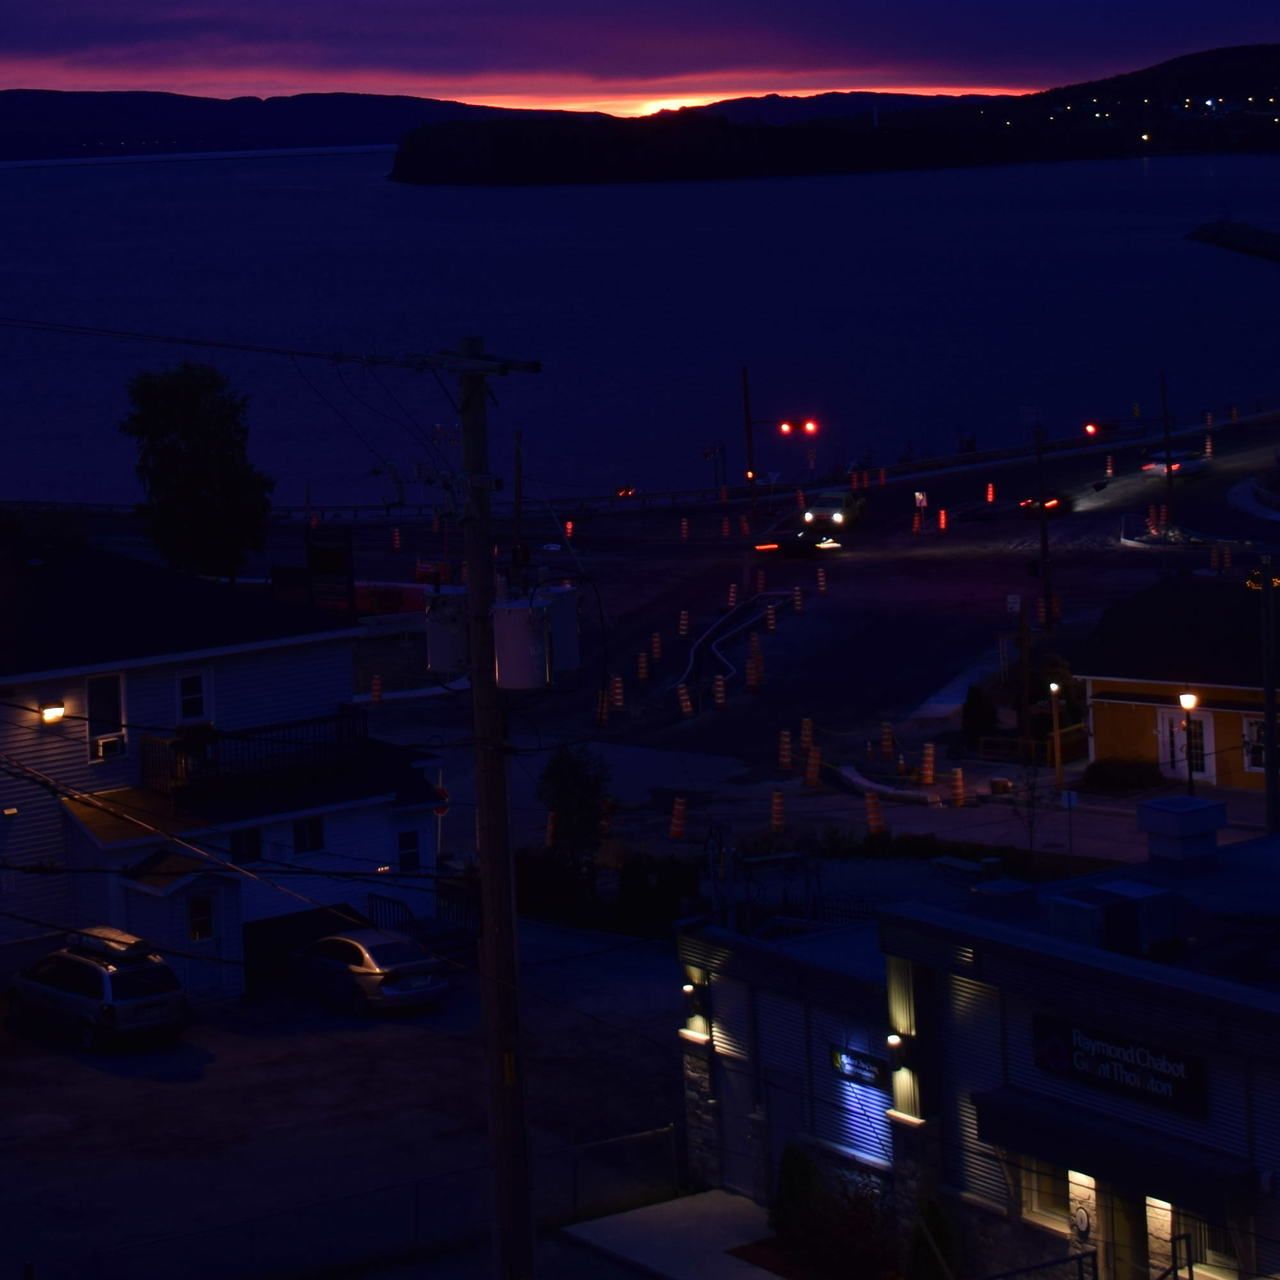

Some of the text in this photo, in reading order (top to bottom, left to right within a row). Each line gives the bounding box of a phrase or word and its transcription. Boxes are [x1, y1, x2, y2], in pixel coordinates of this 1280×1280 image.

[1071, 1027, 1187, 1079] Raymond Chabot
[1072, 1050, 1174, 1097] Gnt Thorton
